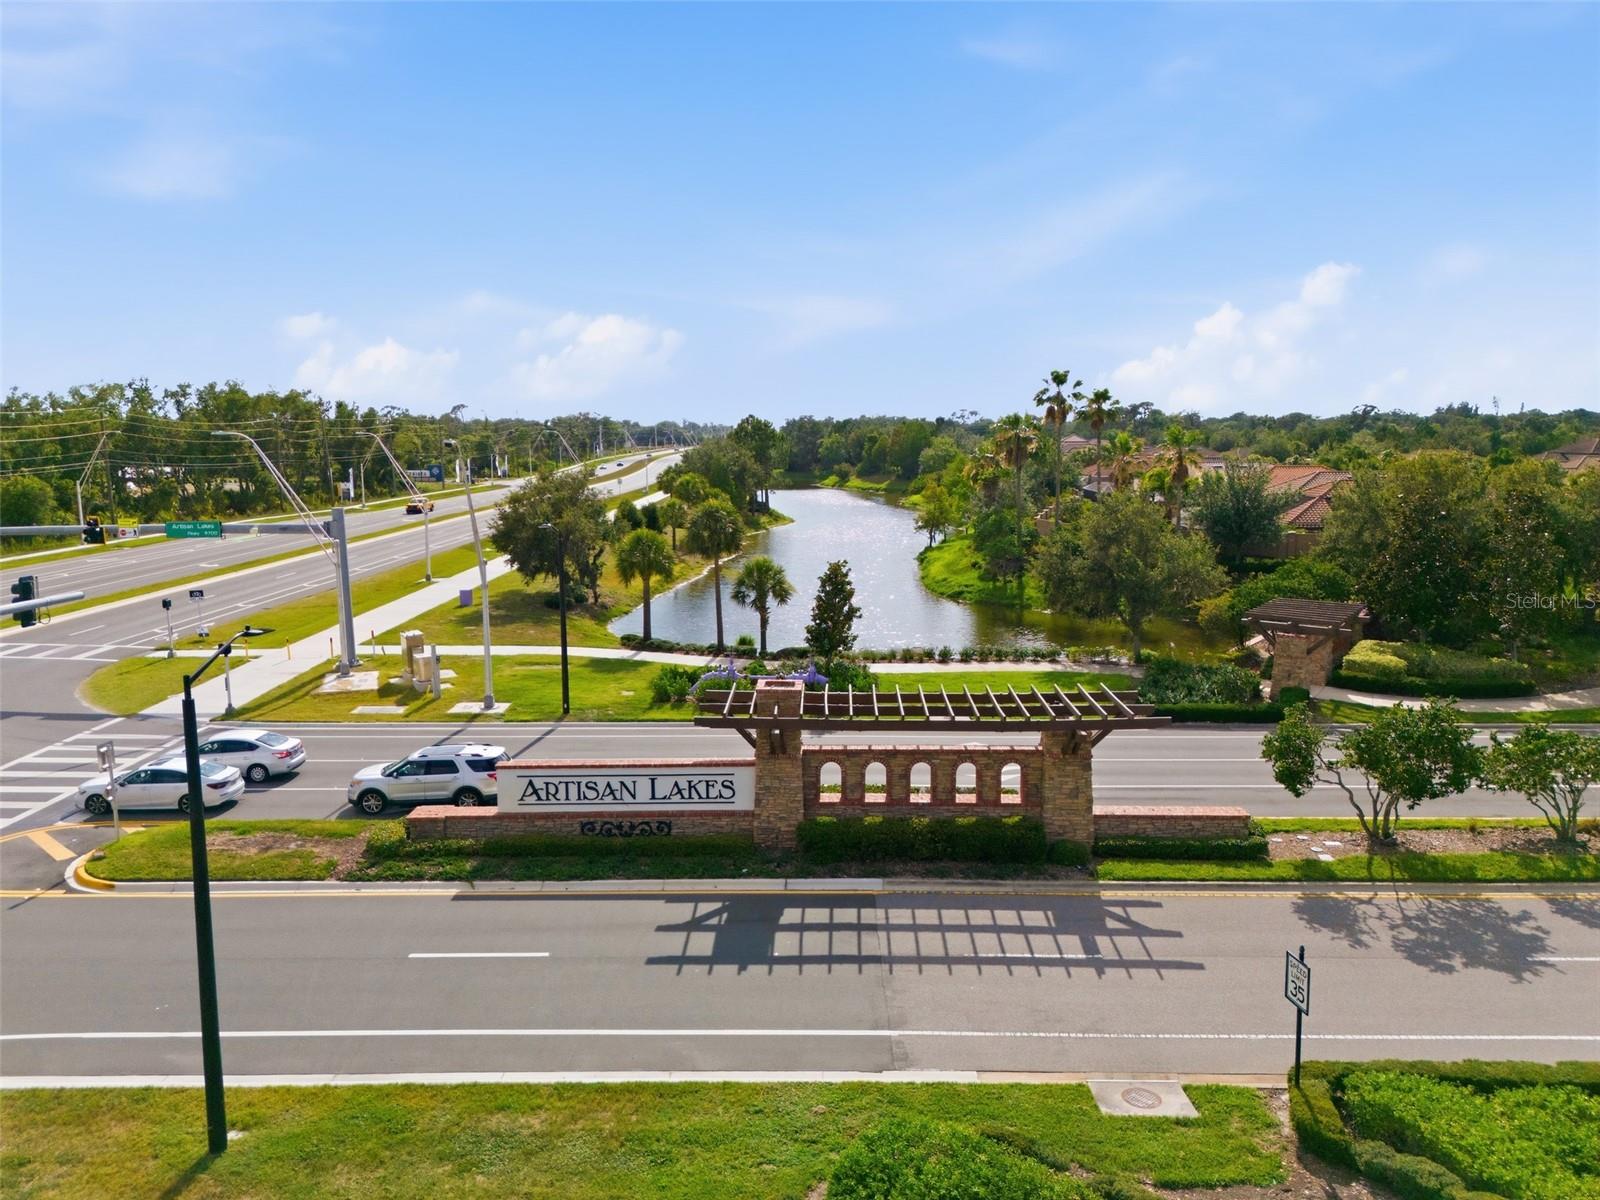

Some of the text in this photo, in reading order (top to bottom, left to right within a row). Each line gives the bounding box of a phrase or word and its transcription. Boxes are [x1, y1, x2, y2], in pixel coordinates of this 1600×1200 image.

[518, 777, 736, 801] ARTISAN LAKES
[1290, 960, 1307, 979] SPEED
[1291, 969, 1305, 986] LIMIT
[1290, 979, 1305, 1004] 35
